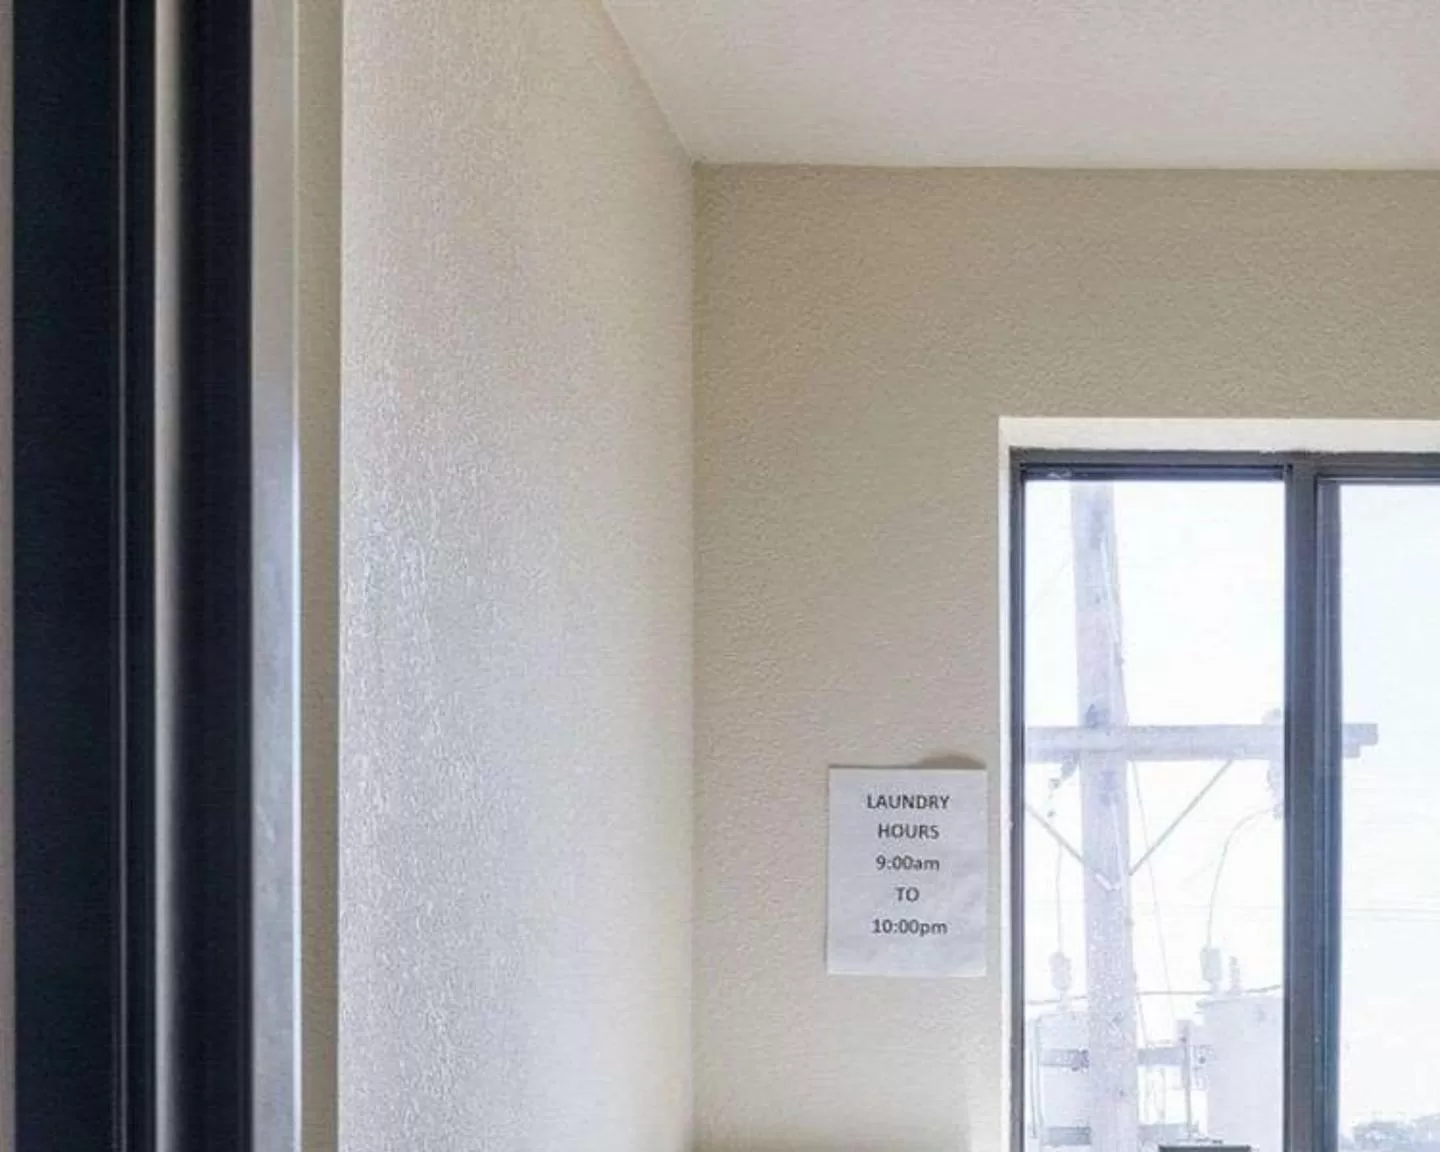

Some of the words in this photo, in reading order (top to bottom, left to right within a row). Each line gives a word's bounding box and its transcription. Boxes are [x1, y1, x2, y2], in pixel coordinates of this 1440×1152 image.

[866, 794, 950, 809] LAUNDRY
[878, 824, 940, 839] HOURS
[875, 855, 940, 871] 9:00am
[896, 887, 919, 901] TO
[872, 918, 948, 937] 10:00pm
